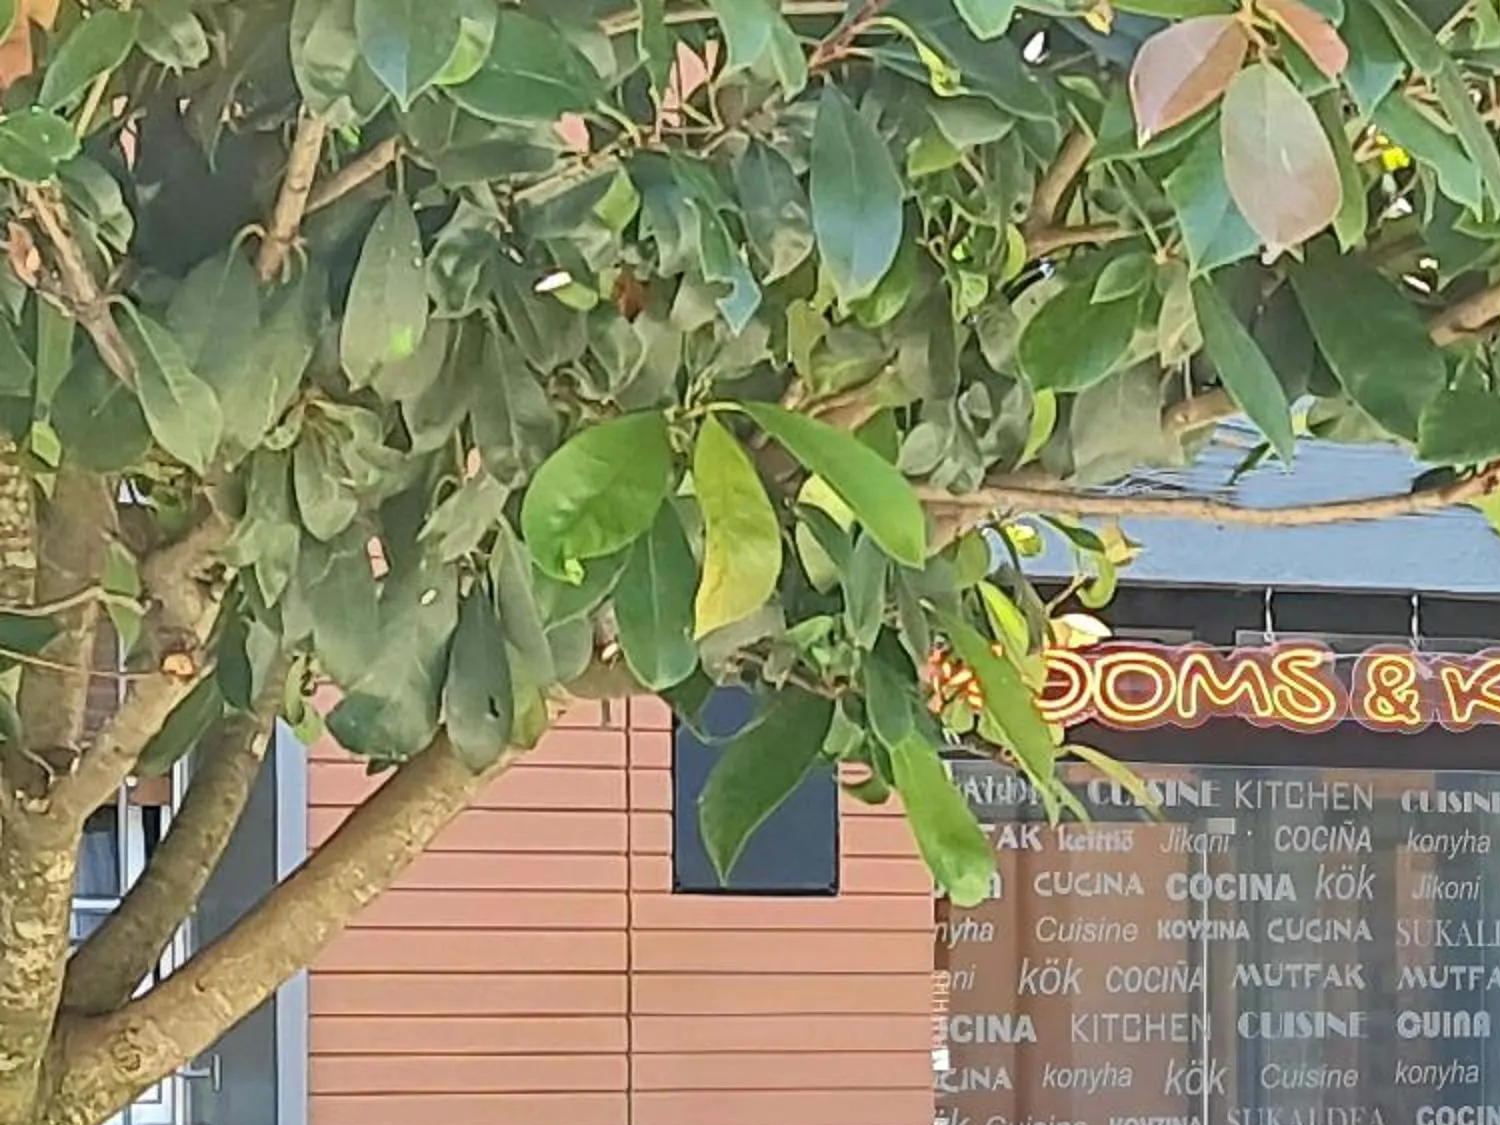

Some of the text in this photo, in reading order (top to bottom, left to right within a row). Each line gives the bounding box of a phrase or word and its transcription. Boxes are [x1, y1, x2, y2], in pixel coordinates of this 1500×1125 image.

[932, 645, 1336, 725] OOMS
[1364, 654, 1420, 726] &
[1087, 780, 1221, 808] CUSINE
[1235, 780, 1374, 812] KITCHEN
[1406, 828, 1491, 857] konyha
[1033, 871, 1145, 898] CUCINA
[1165, 873, 1297, 901] COCINA
[1314, 864, 1376, 901] kök
[1411, 874, 1481, 901] Jikoni
[1035, 916, 1139, 943] Cuisine
[1267, 916, 1374, 945] CUCINA
[1017, 958, 1084, 996] kök
[1232, 963, 1367, 990] MUTFAK
[1071, 1013, 1212, 1043] KITCHEN
[1238, 1012, 1368, 1040] CUISINE
[1042, 1063, 1134, 1095] konyha
[1164, 1059, 1230, 1096] kök
[1261, 1063, 1359, 1090] Cuisine
[1394, 1061, 1480, 1091] konyha
